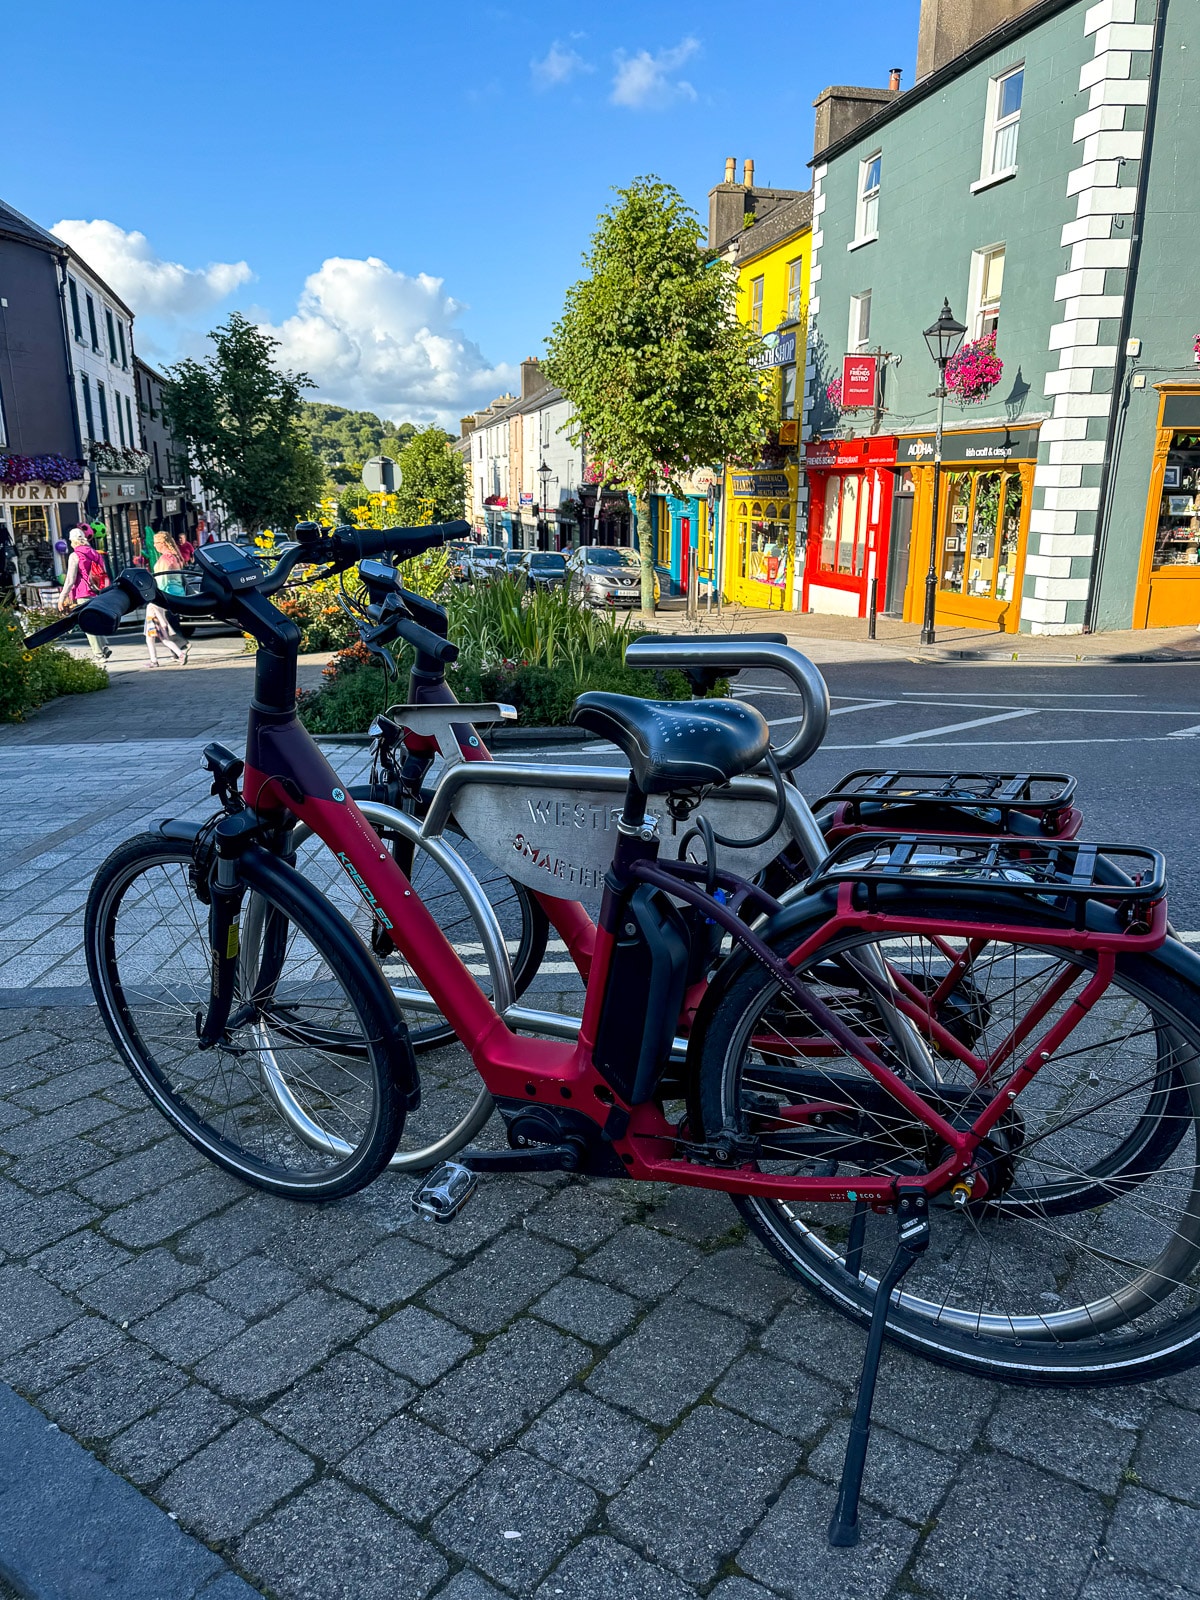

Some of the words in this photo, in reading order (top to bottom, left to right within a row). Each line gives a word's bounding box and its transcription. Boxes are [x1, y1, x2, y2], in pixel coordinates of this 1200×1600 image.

[774, 338, 795, 363] SHOP
[975, 448, 988, 456] craft
[988, 446, 993, 456] &
[993, 447, 1012, 458] design
[837, 455, 859, 464] RESTAURANT
[1, 485, 67, 500] MORAN
[757, 489, 774, 497] HEALTH
[337, 851, 394, 930] KREIDLER
